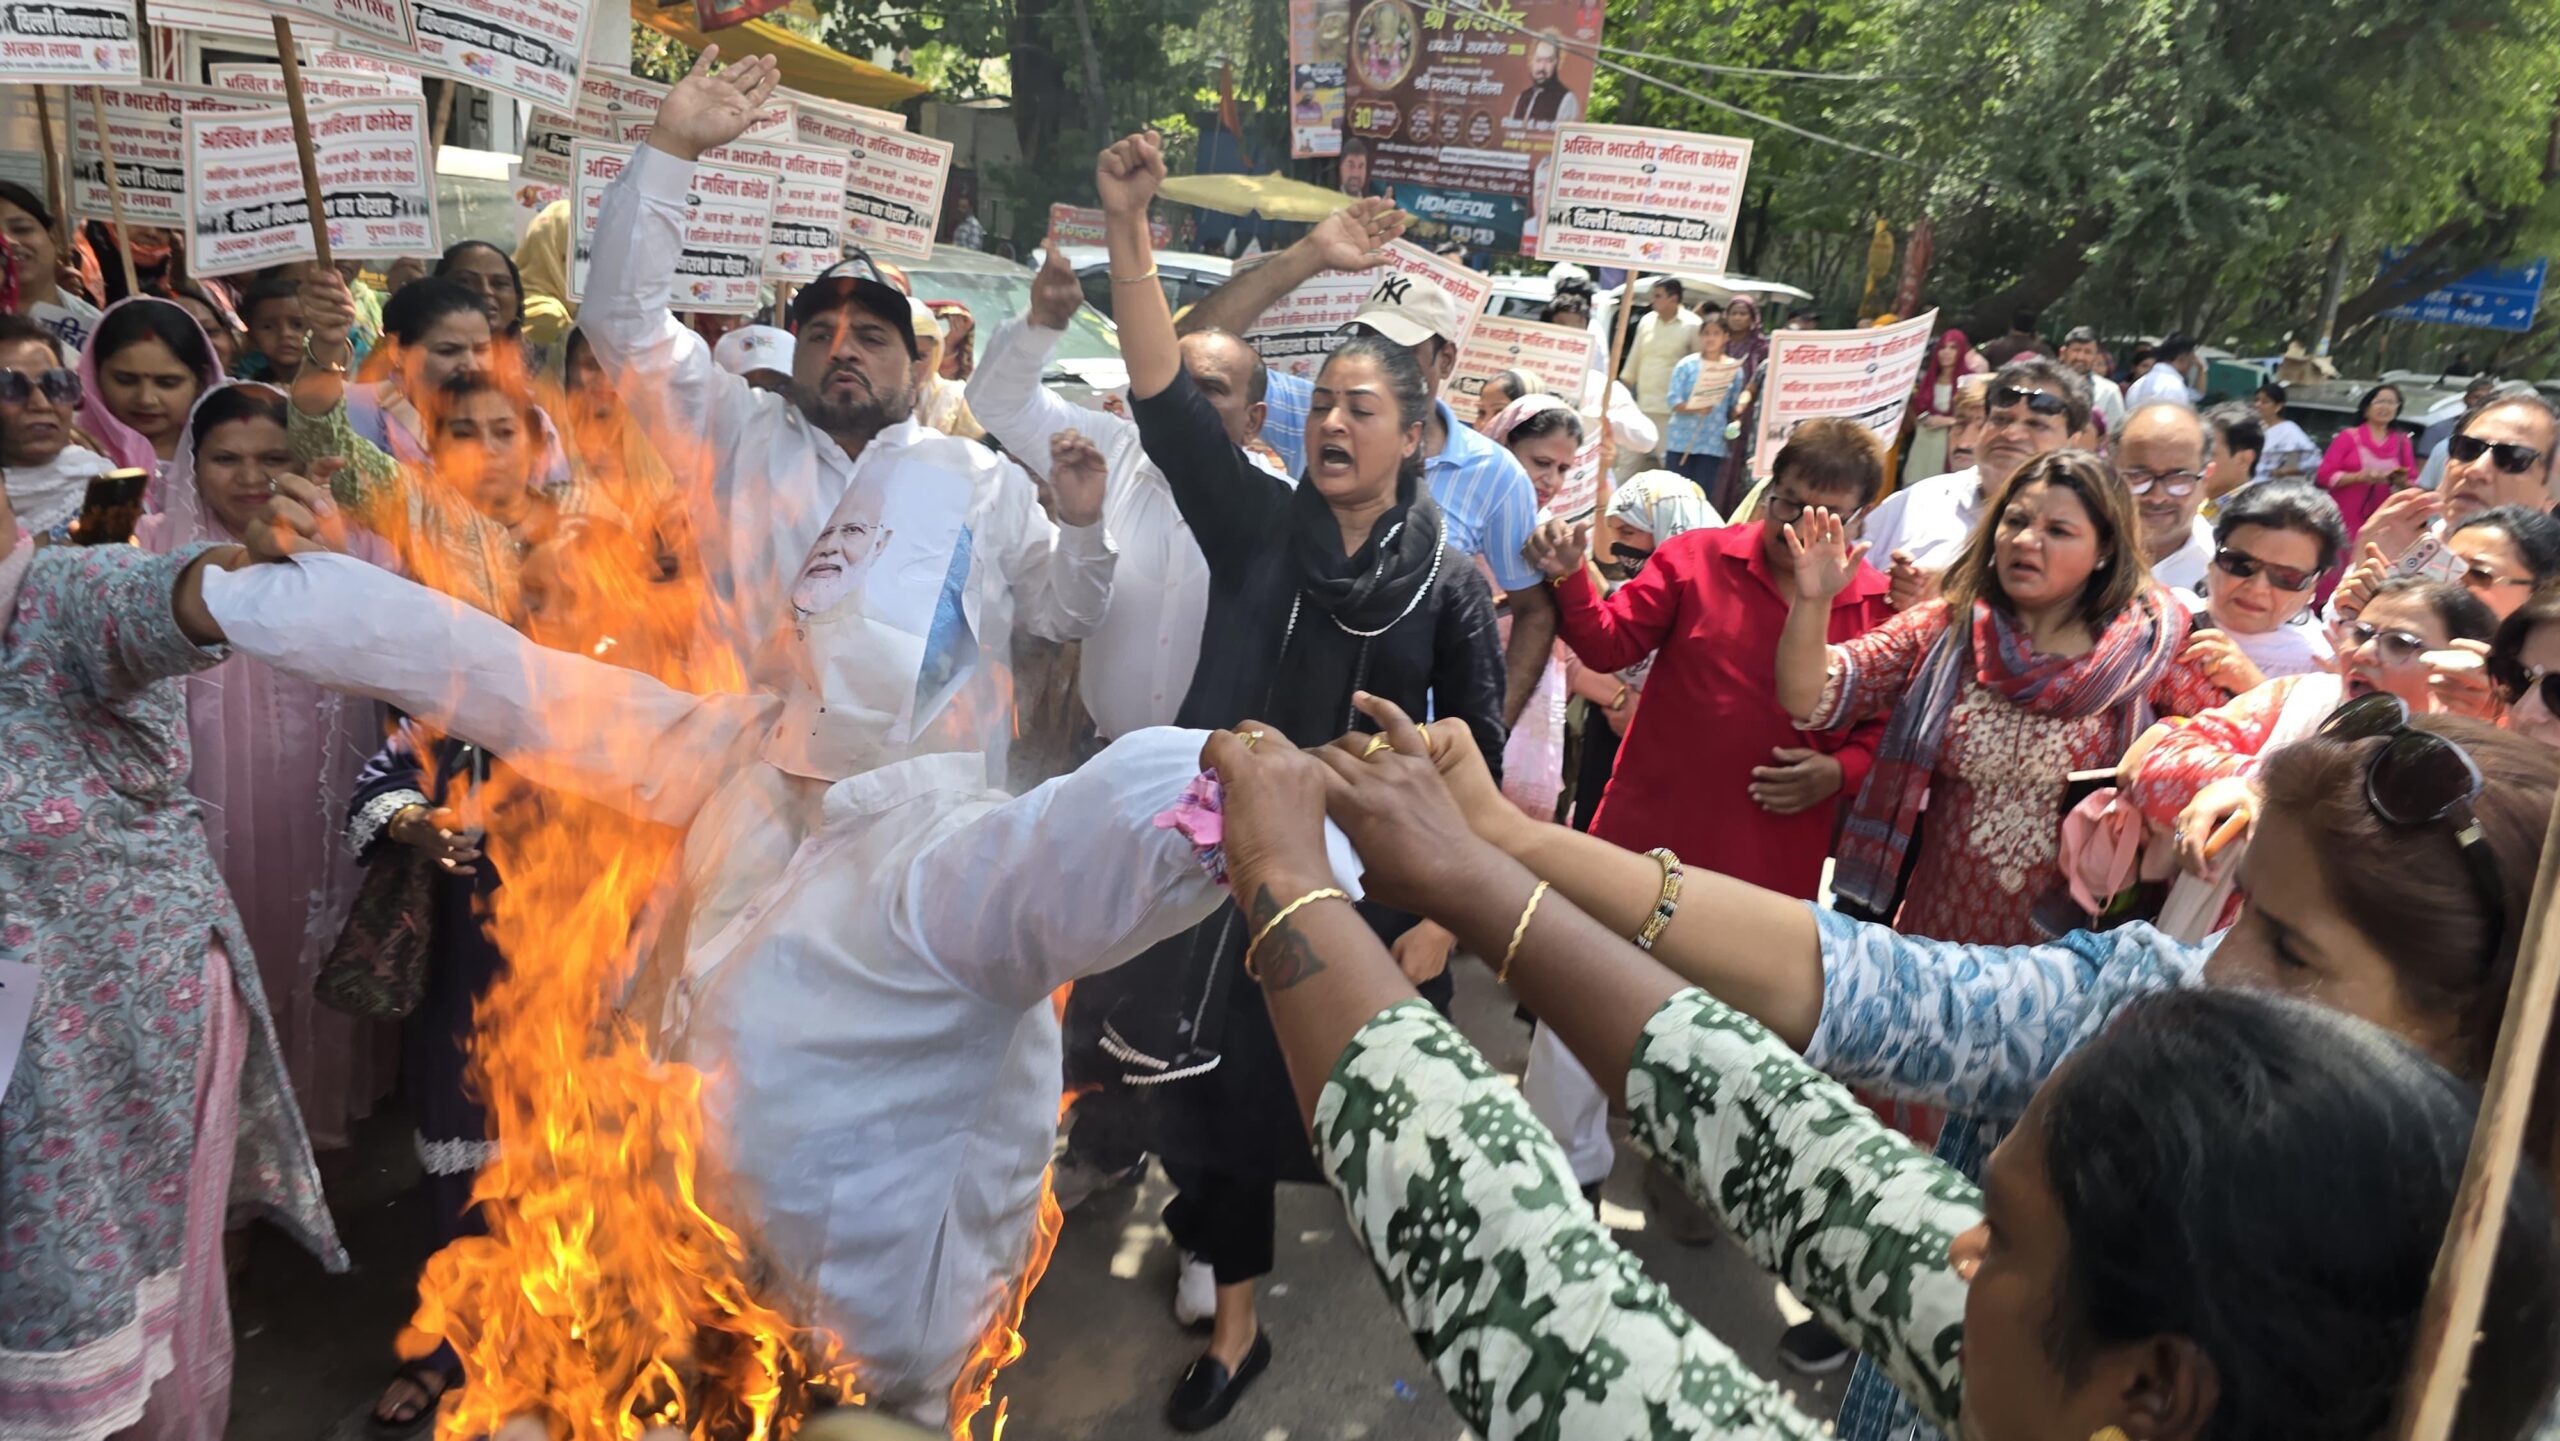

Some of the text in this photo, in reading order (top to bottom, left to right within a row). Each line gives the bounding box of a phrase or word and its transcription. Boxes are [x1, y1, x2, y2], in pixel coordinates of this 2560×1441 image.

[224, 73, 269, 92] अखिल
[124, 91, 181, 113] भारतीय
[200, 126, 258, 149] अखिल
[320, 112, 362, 137] महिला
[364, 108, 413, 132] कांग्रेस
[1353, 106, 1373, 129] 30
[824, 124, 867, 148] भारतीय
[867, 136, 904, 158] महिला
[905, 145, 942, 167] कांग्रेस
[1563, 135, 1740, 170] अखिल भारतीय महिला कांग्रेस
[785, 154, 818, 175] महिला
[701, 173, 738, 197] महिला
[355, 193, 393, 217] घेराव
[885, 202, 910, 225] घेराव
[1415, 194, 1496, 219] HOMEFOIL
[1573, 207, 1706, 240] दिल्ली विधानसभा का घेराव
[709, 257, 724, 274] का
[723, 254, 746, 276] घेराव
[1444, 277, 1480, 304] कांग्रेस
[2451, 307, 2495, 326] Road
[1782, 344, 1831, 366] अखिल
[1834, 341, 1879, 363] भारतीय
